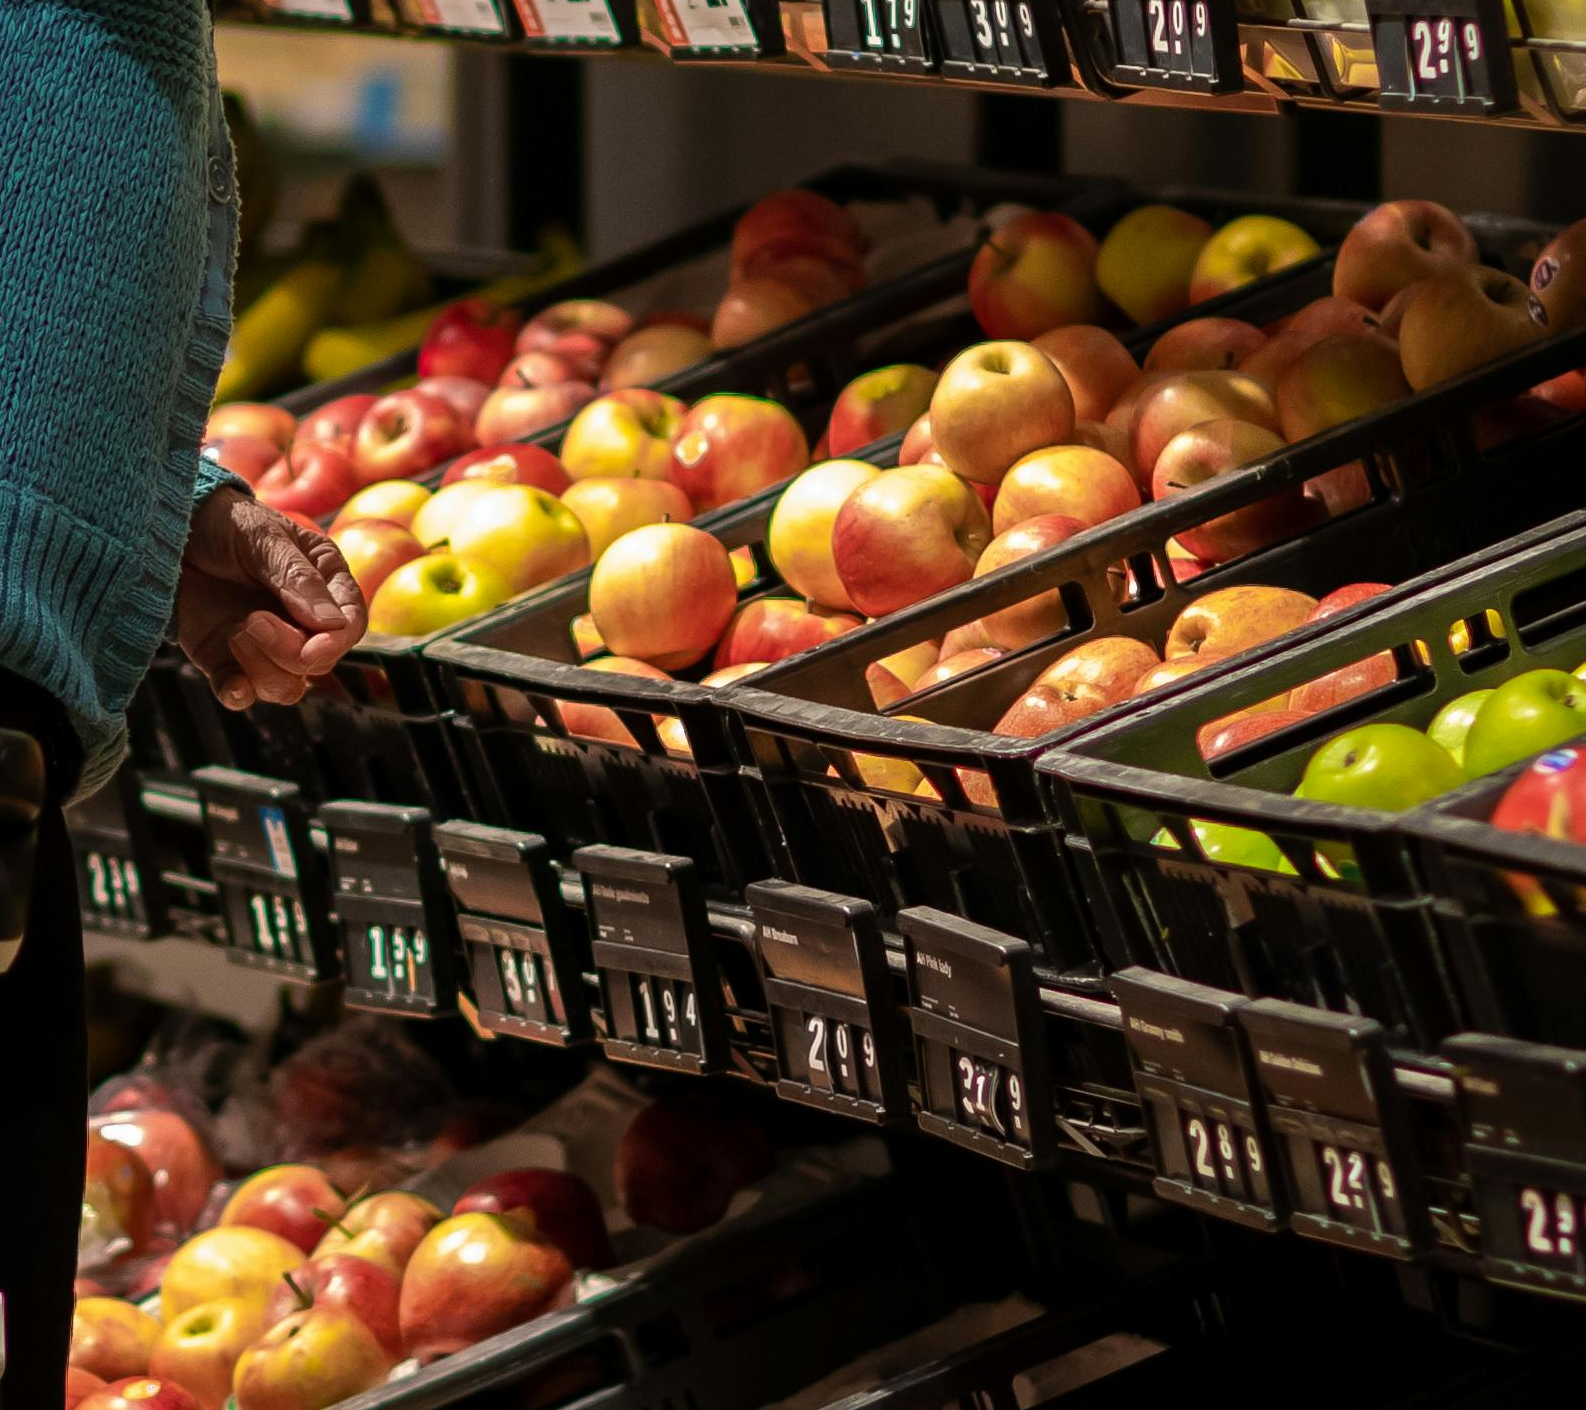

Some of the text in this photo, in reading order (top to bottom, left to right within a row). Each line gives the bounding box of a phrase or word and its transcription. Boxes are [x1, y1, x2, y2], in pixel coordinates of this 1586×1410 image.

[917, 952, 951, 978] AH Pink lady
